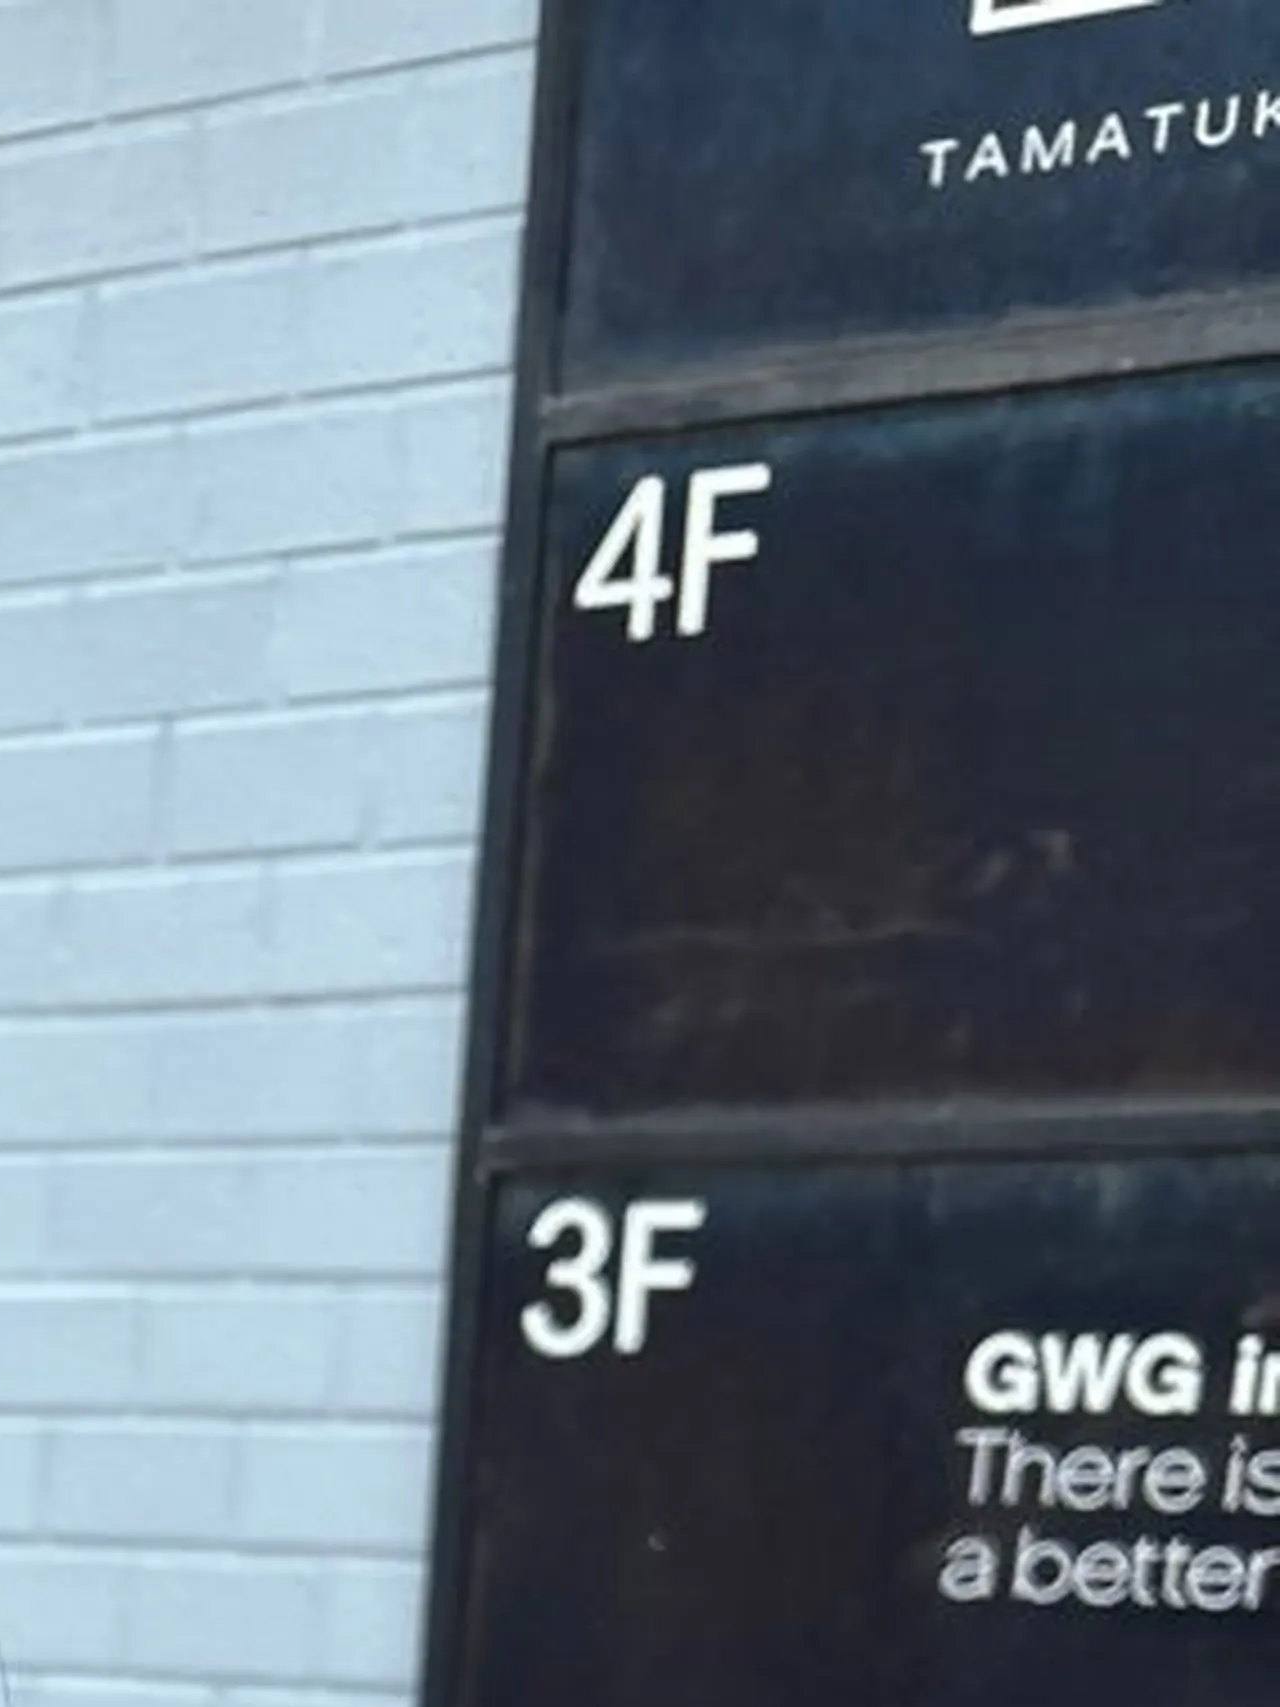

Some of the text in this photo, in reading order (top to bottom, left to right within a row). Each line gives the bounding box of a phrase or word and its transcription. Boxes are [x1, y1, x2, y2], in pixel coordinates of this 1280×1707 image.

[574, 462, 772, 641] 4F
[521, 1197, 707, 1358] 3F
[965, 1331, 1203, 1415] GWG
[956, 1426, 1207, 1514] There
[938, 1524, 1280, 1612] a better
